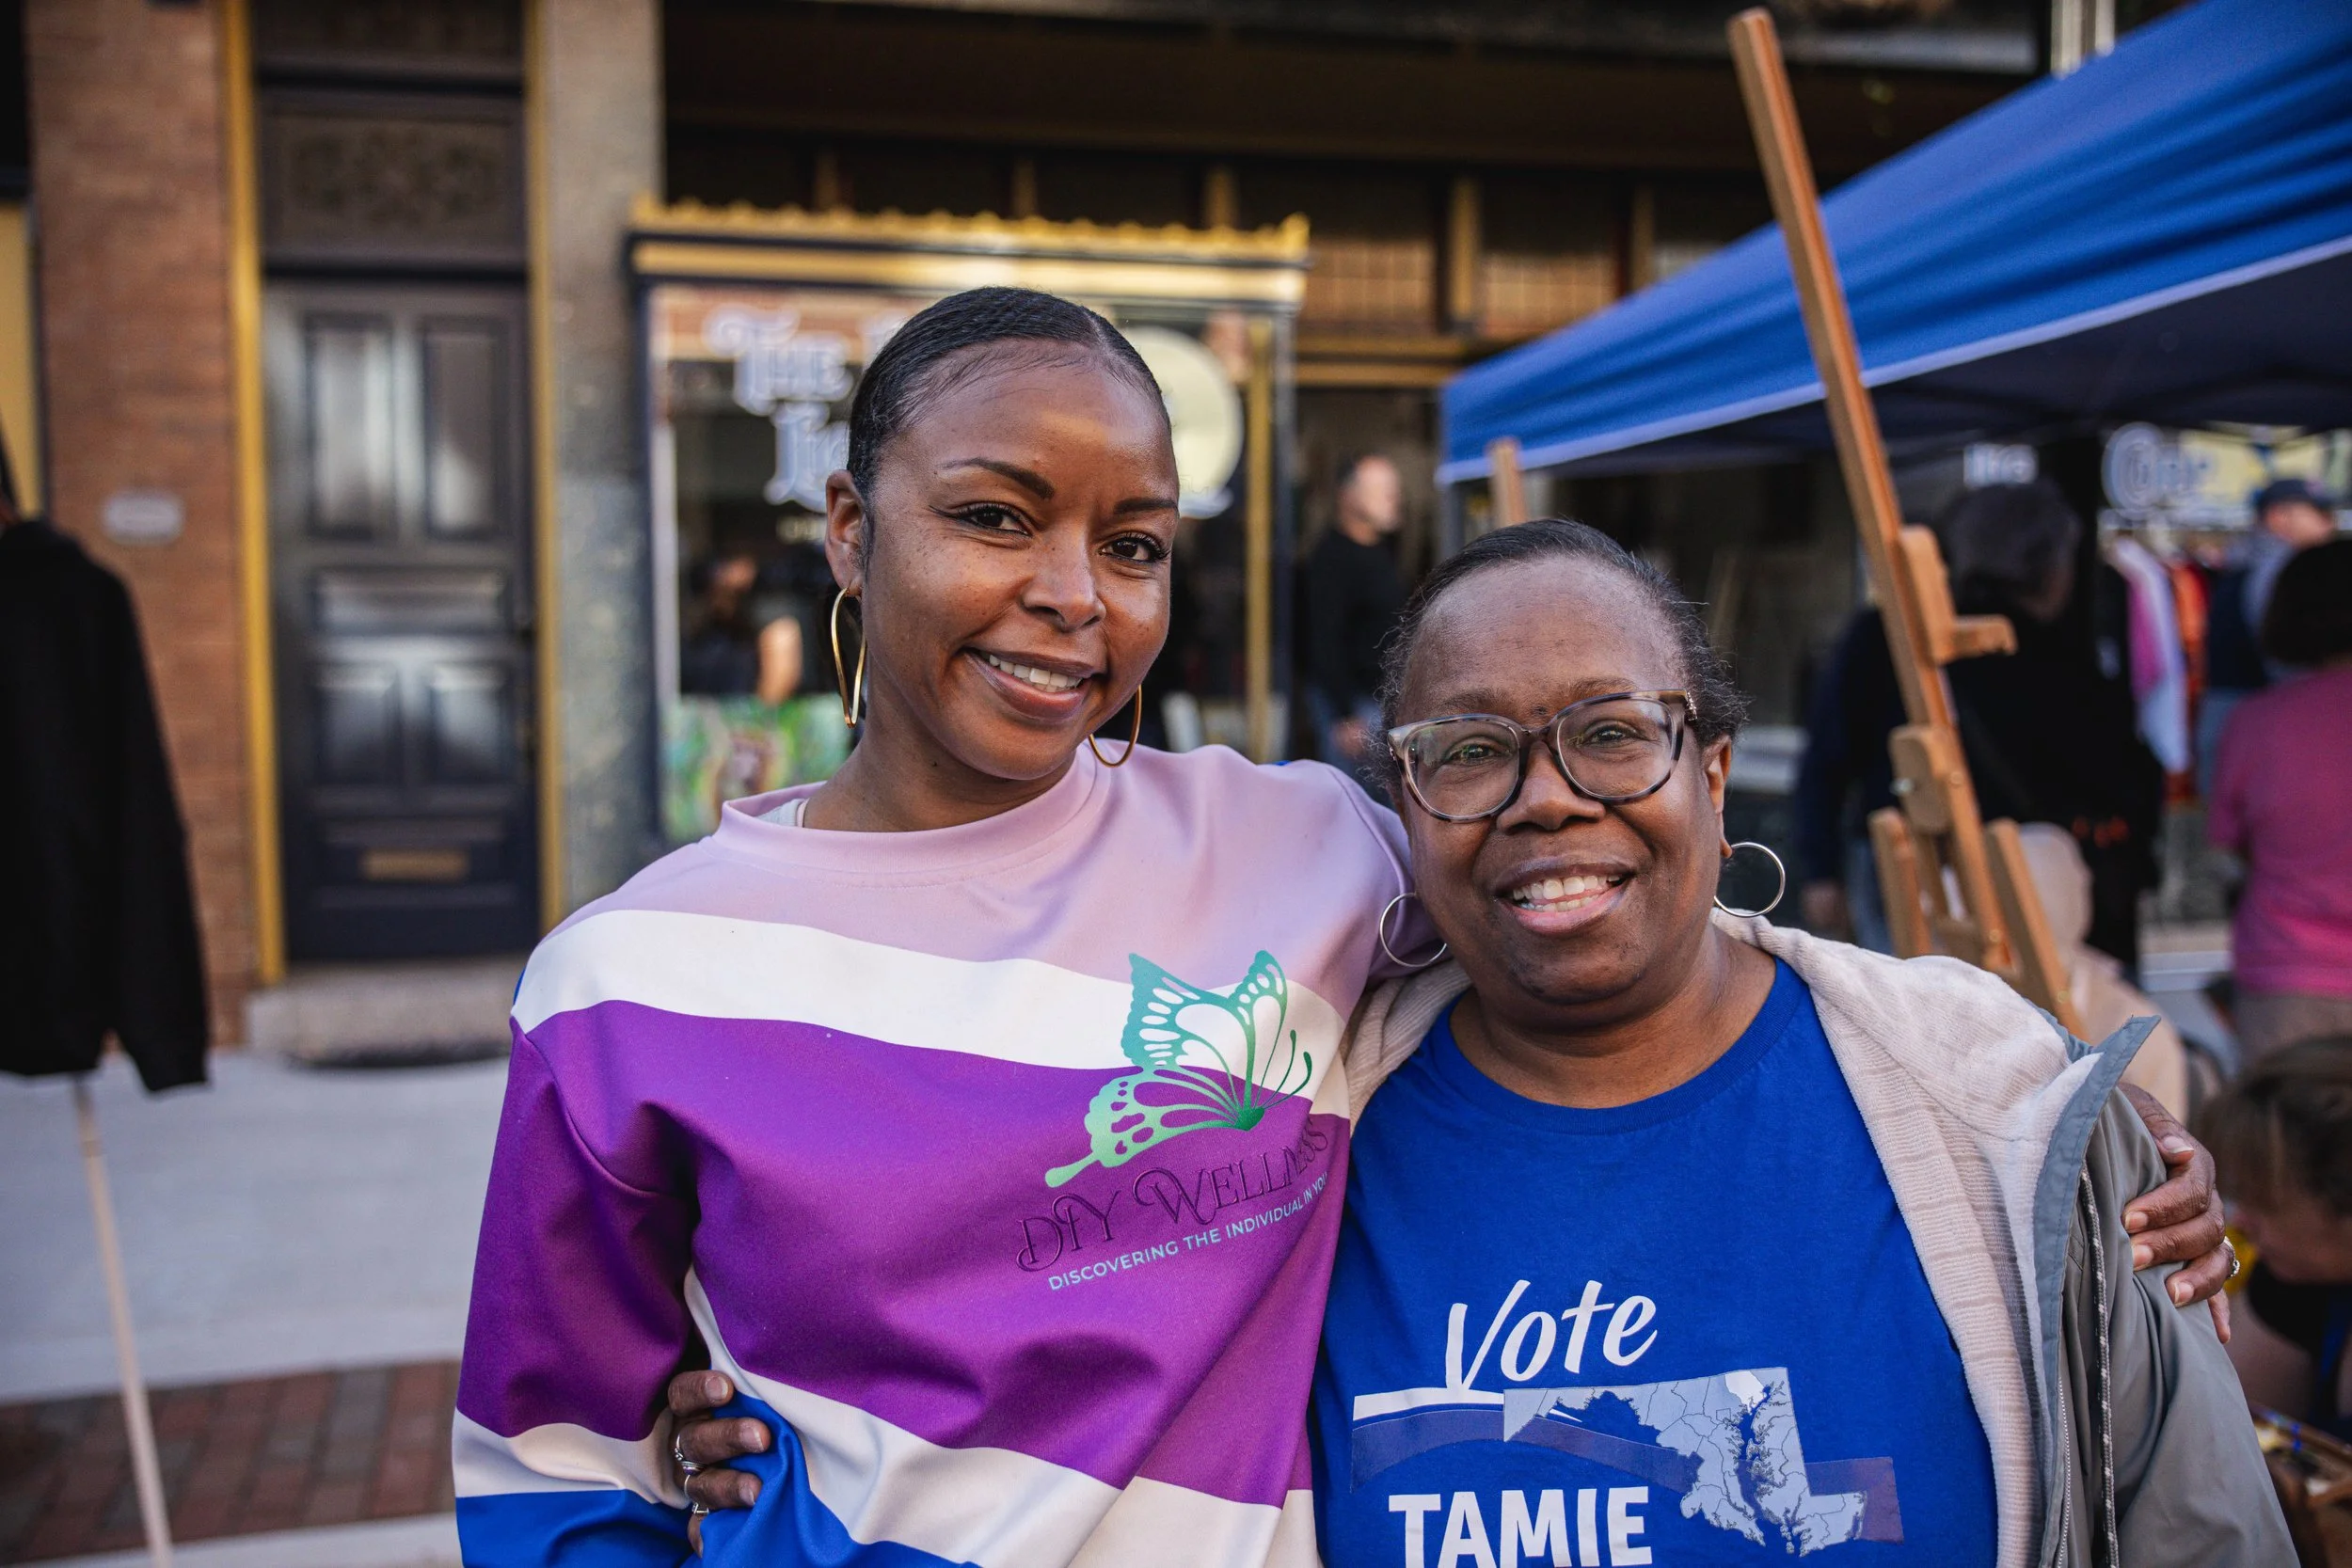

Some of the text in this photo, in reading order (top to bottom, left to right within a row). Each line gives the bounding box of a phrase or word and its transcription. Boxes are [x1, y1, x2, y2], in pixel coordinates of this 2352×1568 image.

[1016, 1190, 1121, 1272] DIY
[1048, 1241, 1179, 1291] DISCOVERING
[1183, 1227, 1221, 1251] THE
[1226, 1196, 1304, 1239] INDIVIDUAL
[1303, 1187, 1312, 1205] IN
[1445, 1279, 1658, 1390] Vote
[1388, 1485, 1653, 1568] TAMIE
